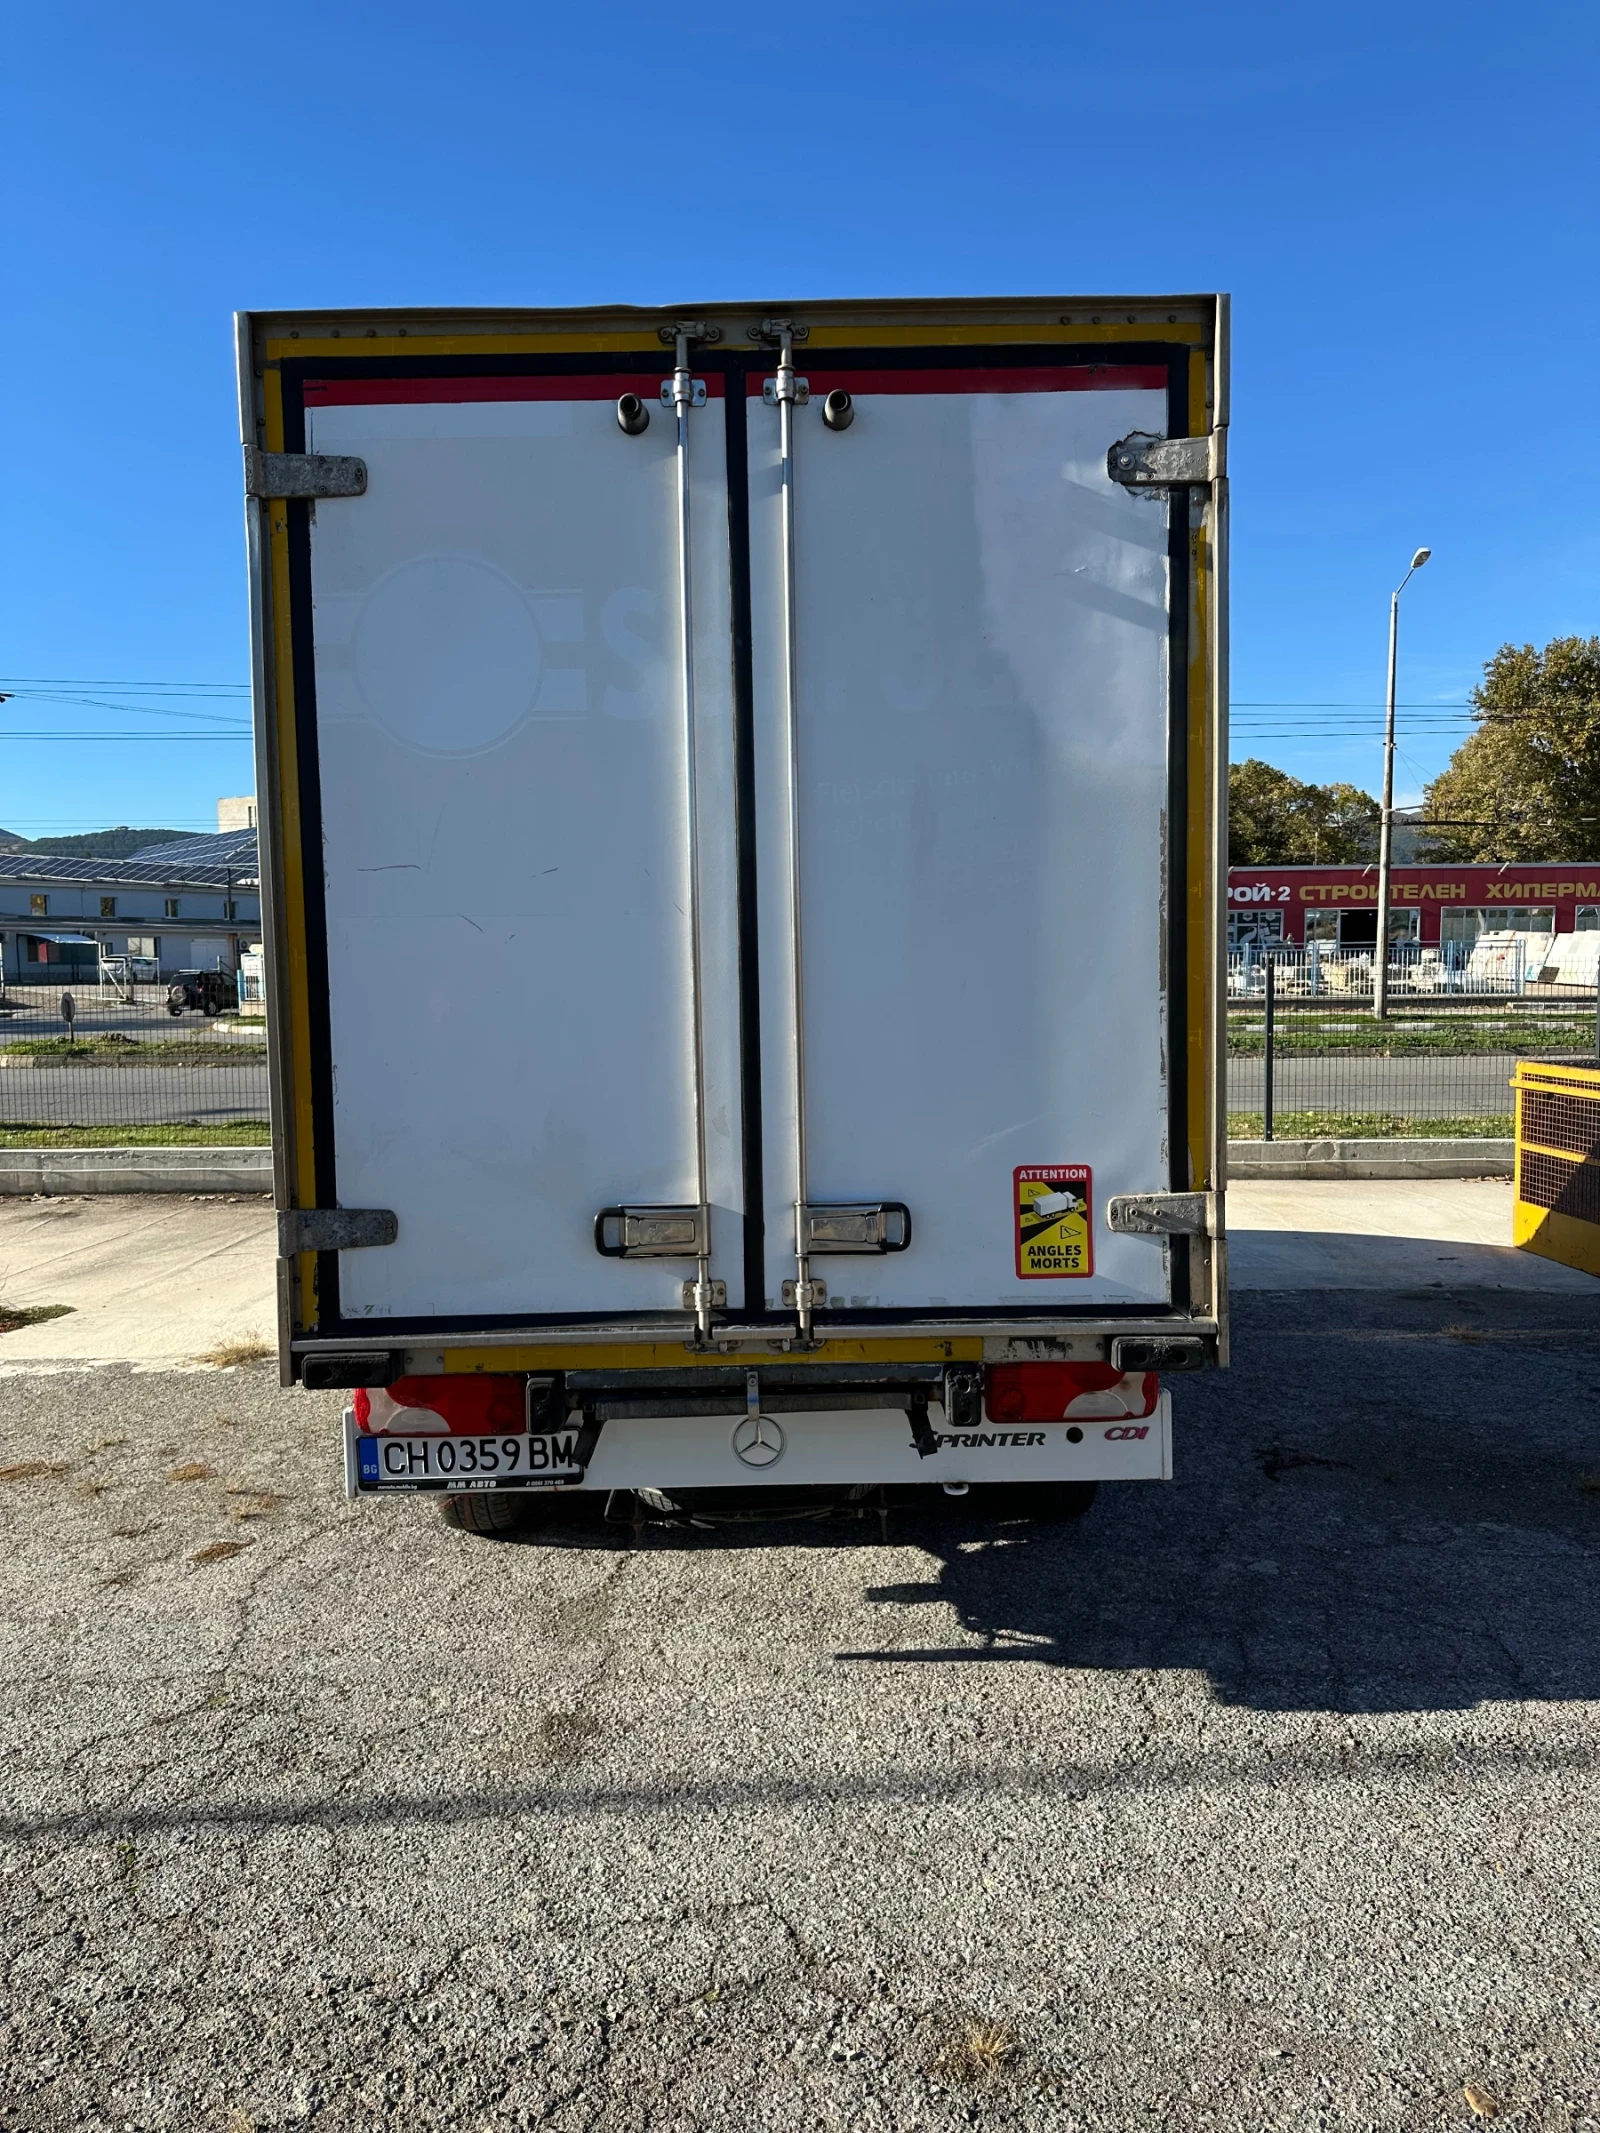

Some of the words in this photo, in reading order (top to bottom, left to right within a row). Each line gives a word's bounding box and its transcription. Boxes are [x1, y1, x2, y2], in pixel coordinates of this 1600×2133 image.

[1299, 884, 1466, 901] СТРОИТЕЛЕН
[1019, 1169, 1087, 1180] ATTENTION
[1027, 1245, 1082, 1256] ANGLES
[1030, 1257, 1080, 1269] MORTS
[935, 1432, 1046, 1448] PRINTER
[1104, 1426, 1150, 1441] CDI
[437, 1438, 521, 1473] 0359
[528, 1435, 573, 1470] BM
[363, 1464, 378, 1474] BG
